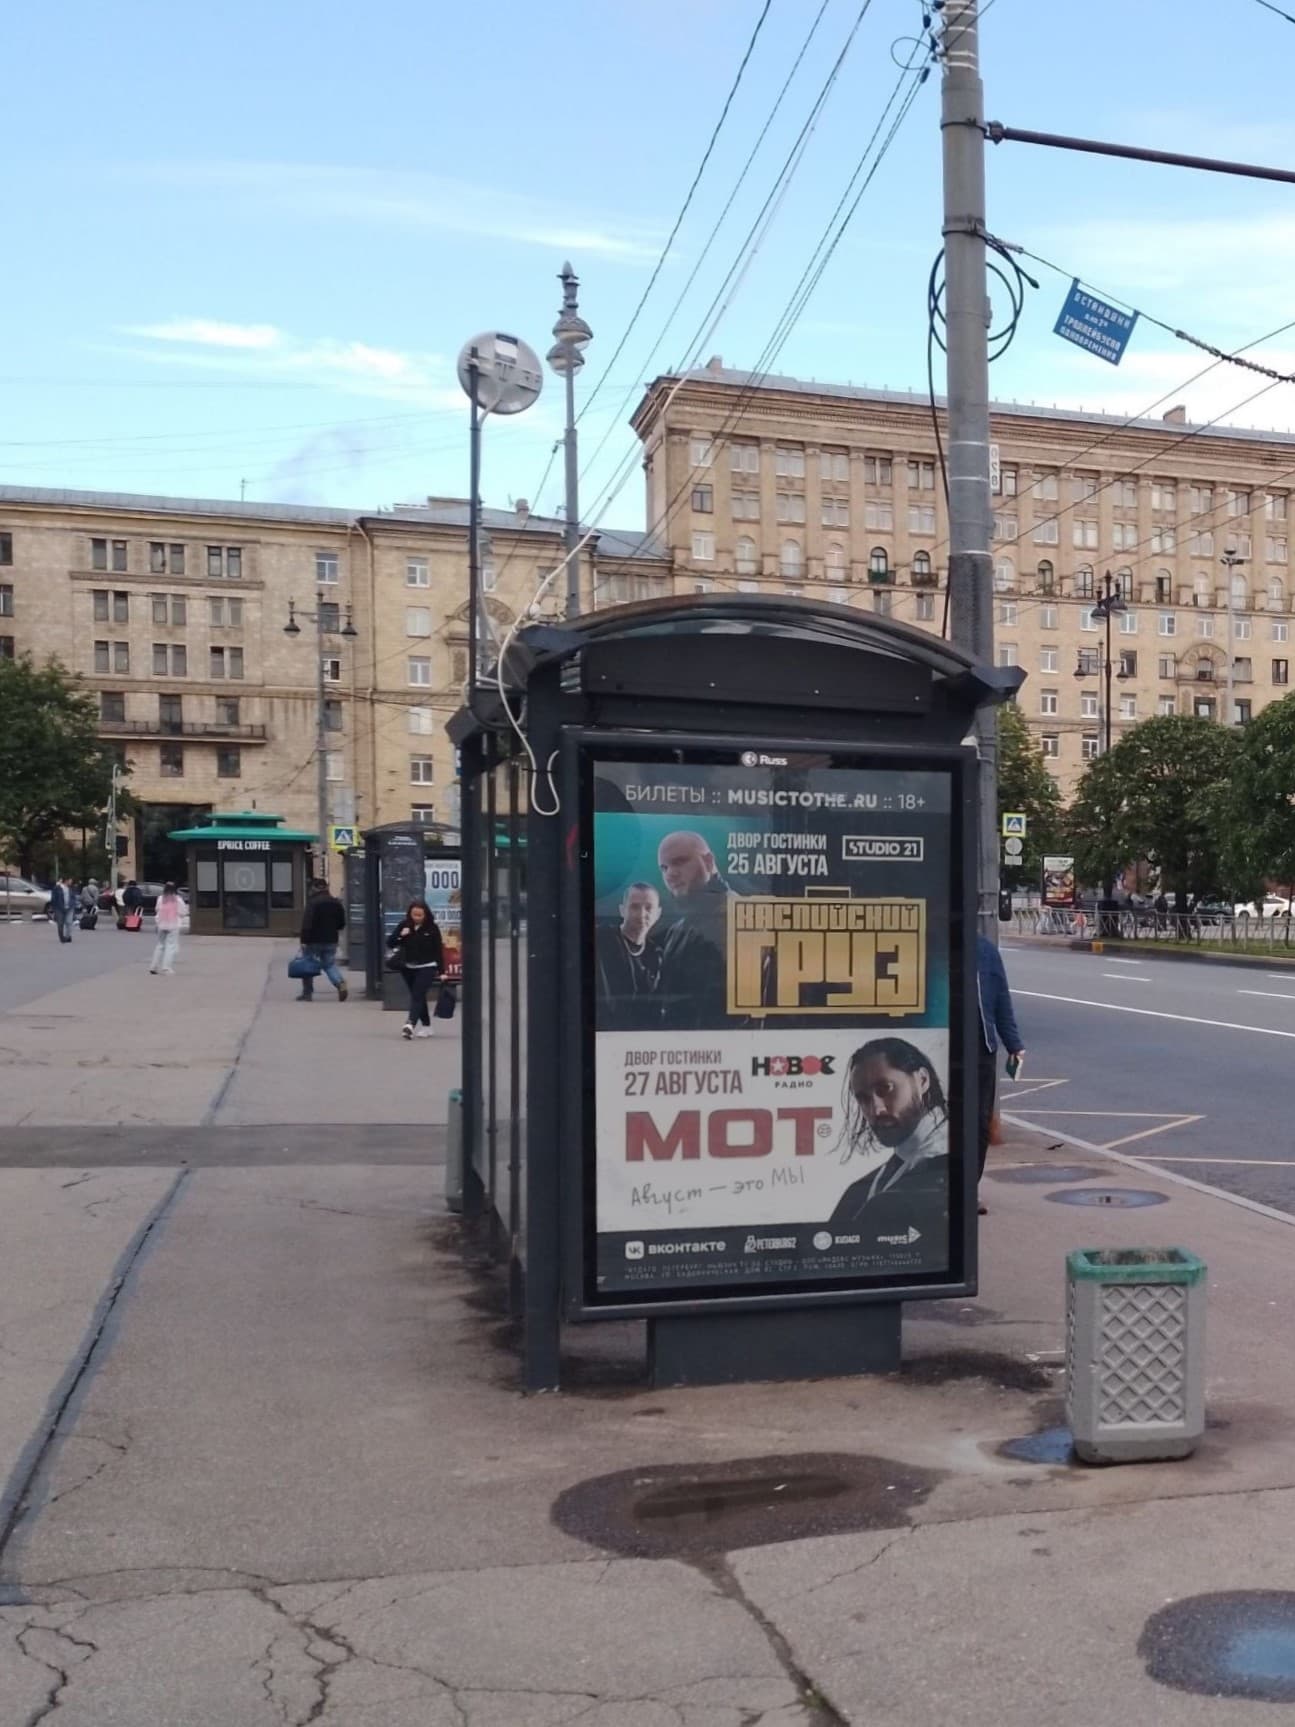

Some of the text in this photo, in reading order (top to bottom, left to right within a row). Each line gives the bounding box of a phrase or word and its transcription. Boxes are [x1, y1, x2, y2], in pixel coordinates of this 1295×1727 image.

[759, 755, 788, 765] Russ
[625, 785, 705, 803] БИЛЕТЫ
[727, 789, 878, 808] MUSICTOTHE.RU
[898, 793, 926, 809] 18+
[727, 832, 827, 850] ДВОР ГОСТИНКИ
[849, 841, 918, 856] STUDIO 21
[727, 853, 829, 876] 25 АВГУСТА
[737, 904, 919, 930] КАСПИЙСКИЙ
[737, 931, 918, 1007] ГРУЗ
[624, 1050, 722, 1067] ДВОР ГОСТИНКИ
[624, 1070, 743, 1096] 27 АВГУСТА
[774, 1080, 813, 1089] РАДИО
[625, 1106, 833, 1162] МОТ
[631, 1183, 702, 1215] Август
[732, 1180, 764, 1194] это
[771, 1165, 804, 1186] МЫ
